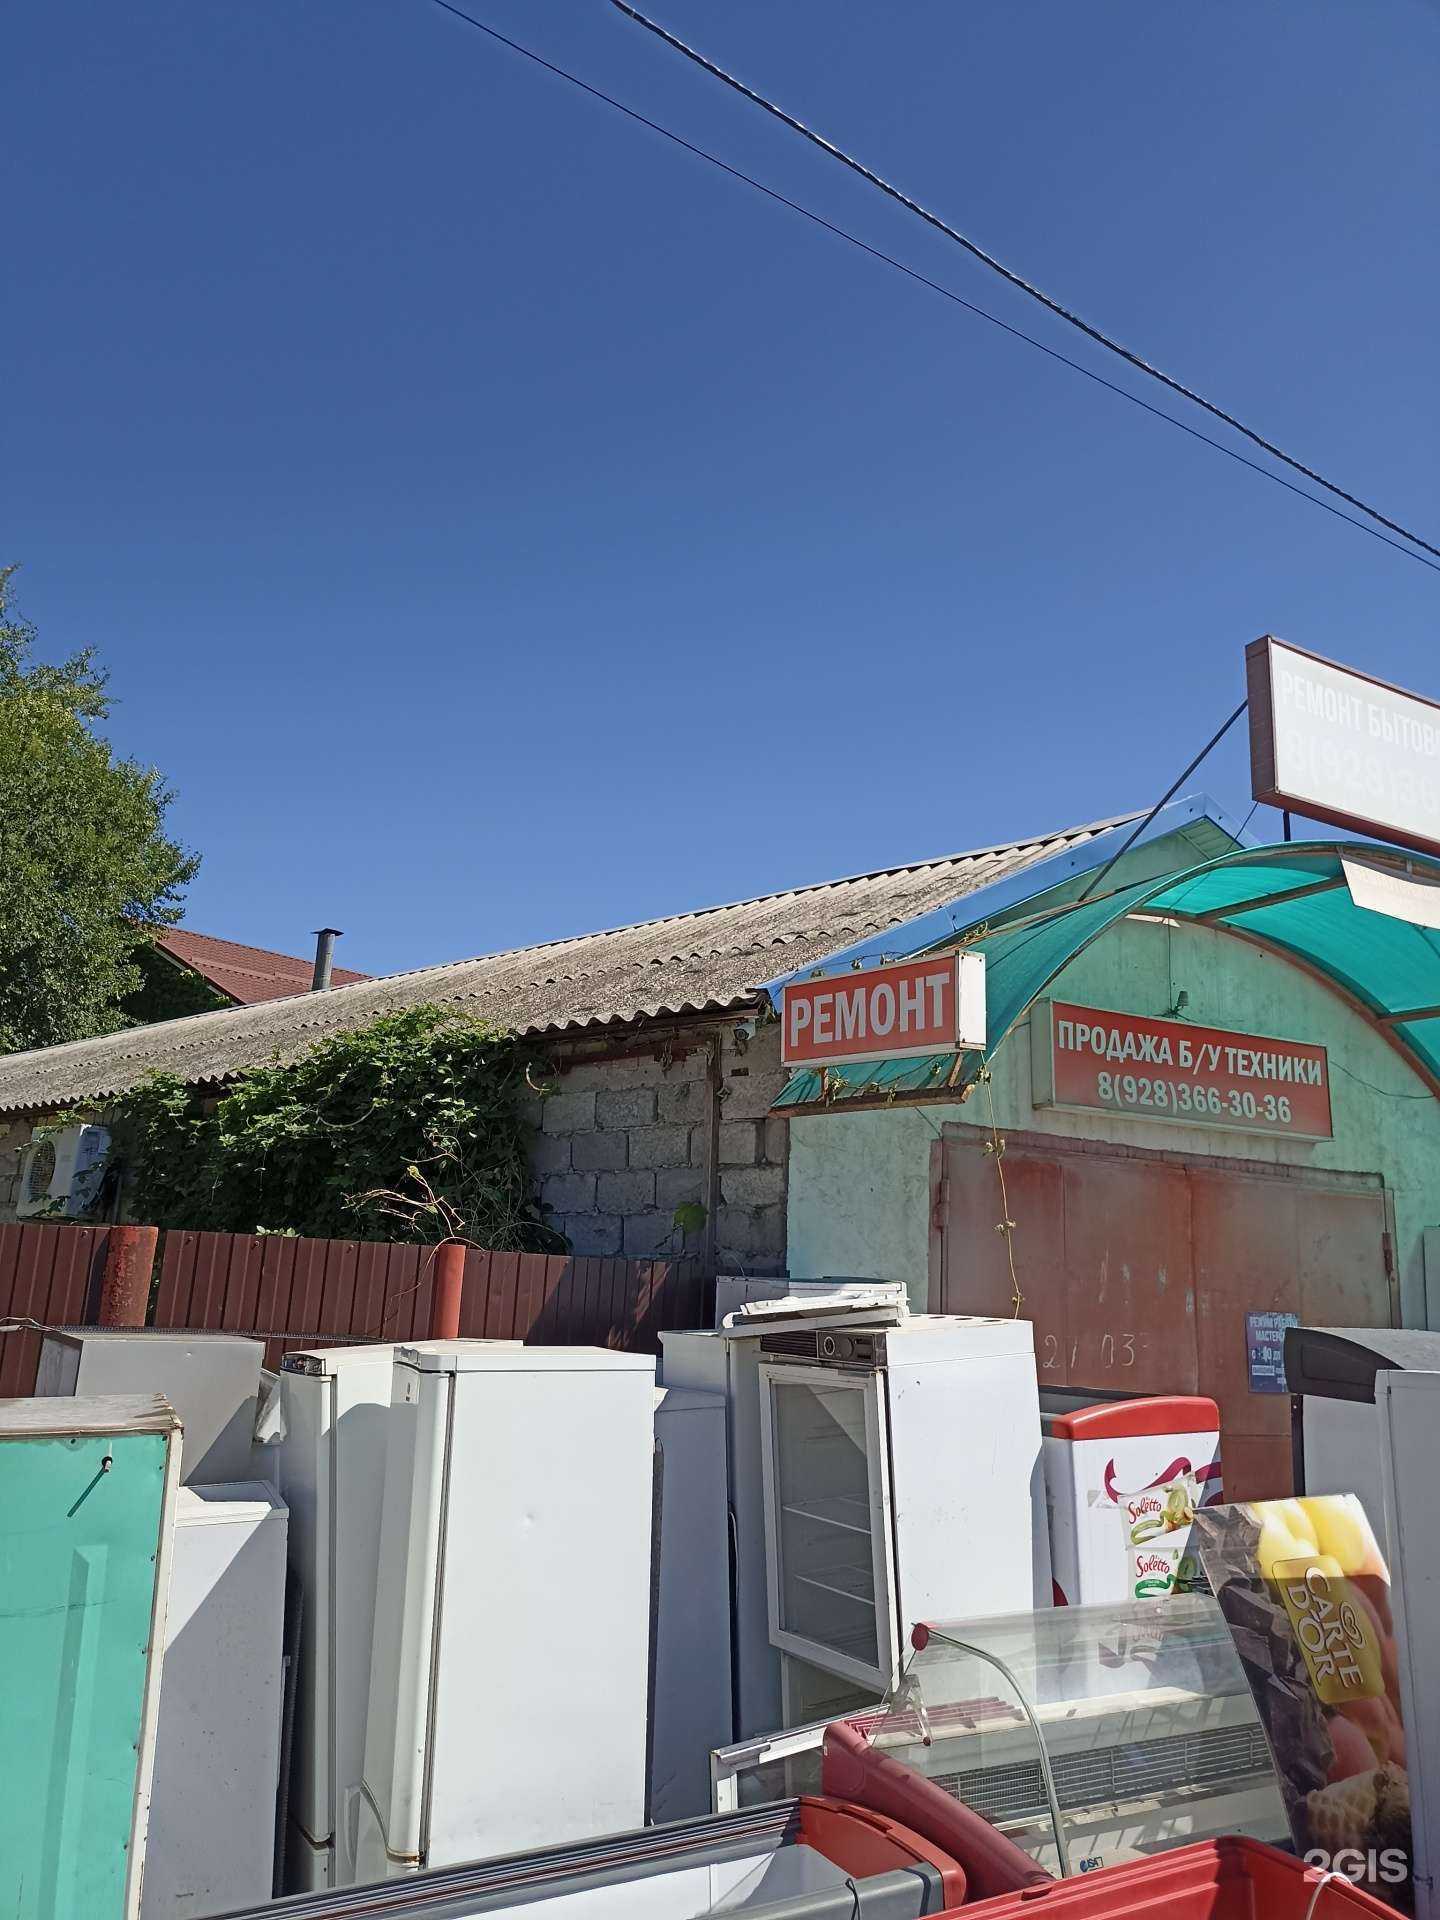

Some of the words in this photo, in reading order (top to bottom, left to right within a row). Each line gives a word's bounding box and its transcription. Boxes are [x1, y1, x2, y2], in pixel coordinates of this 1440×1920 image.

[1280, 669, 1362, 731] РЕМОНТ
[790, 972, 950, 1047] РЕМОНТ
[1058, 1020, 1174, 1066] ПРОДАЖА
[1224, 1047, 1322, 1086] ТЕХНИКИ
[1097, 1071, 1292, 1124] 8(928)366-30-36
[1305, 1567, 1364, 1688] CARTE
